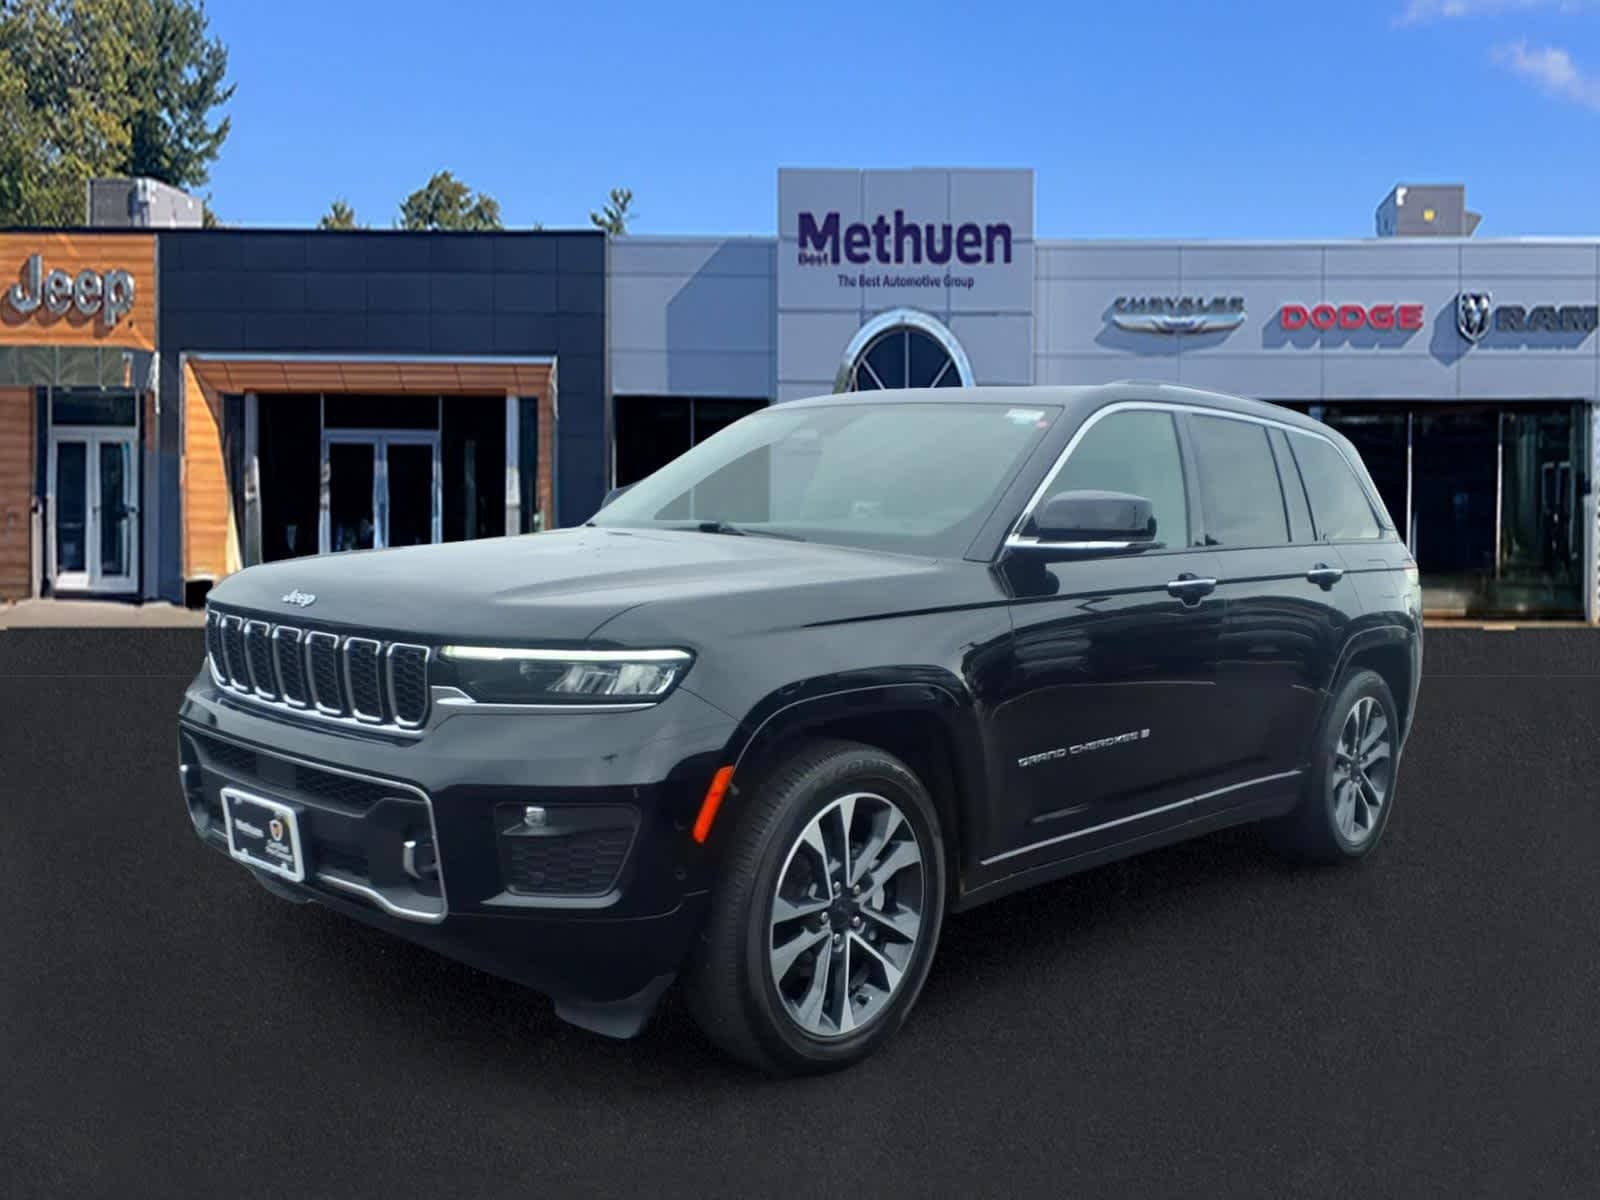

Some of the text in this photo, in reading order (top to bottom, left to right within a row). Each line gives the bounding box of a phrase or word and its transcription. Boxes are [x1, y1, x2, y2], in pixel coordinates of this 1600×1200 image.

[798, 210, 1013, 265] Methuen
[9, 253, 135, 326] Jeep
[838, 274, 974, 291] The Best Automotive Group
[1281, 303, 1425, 331] DODGE
[1495, 306, 1599, 332] RAM
[282, 588, 317, 607] Jeep
